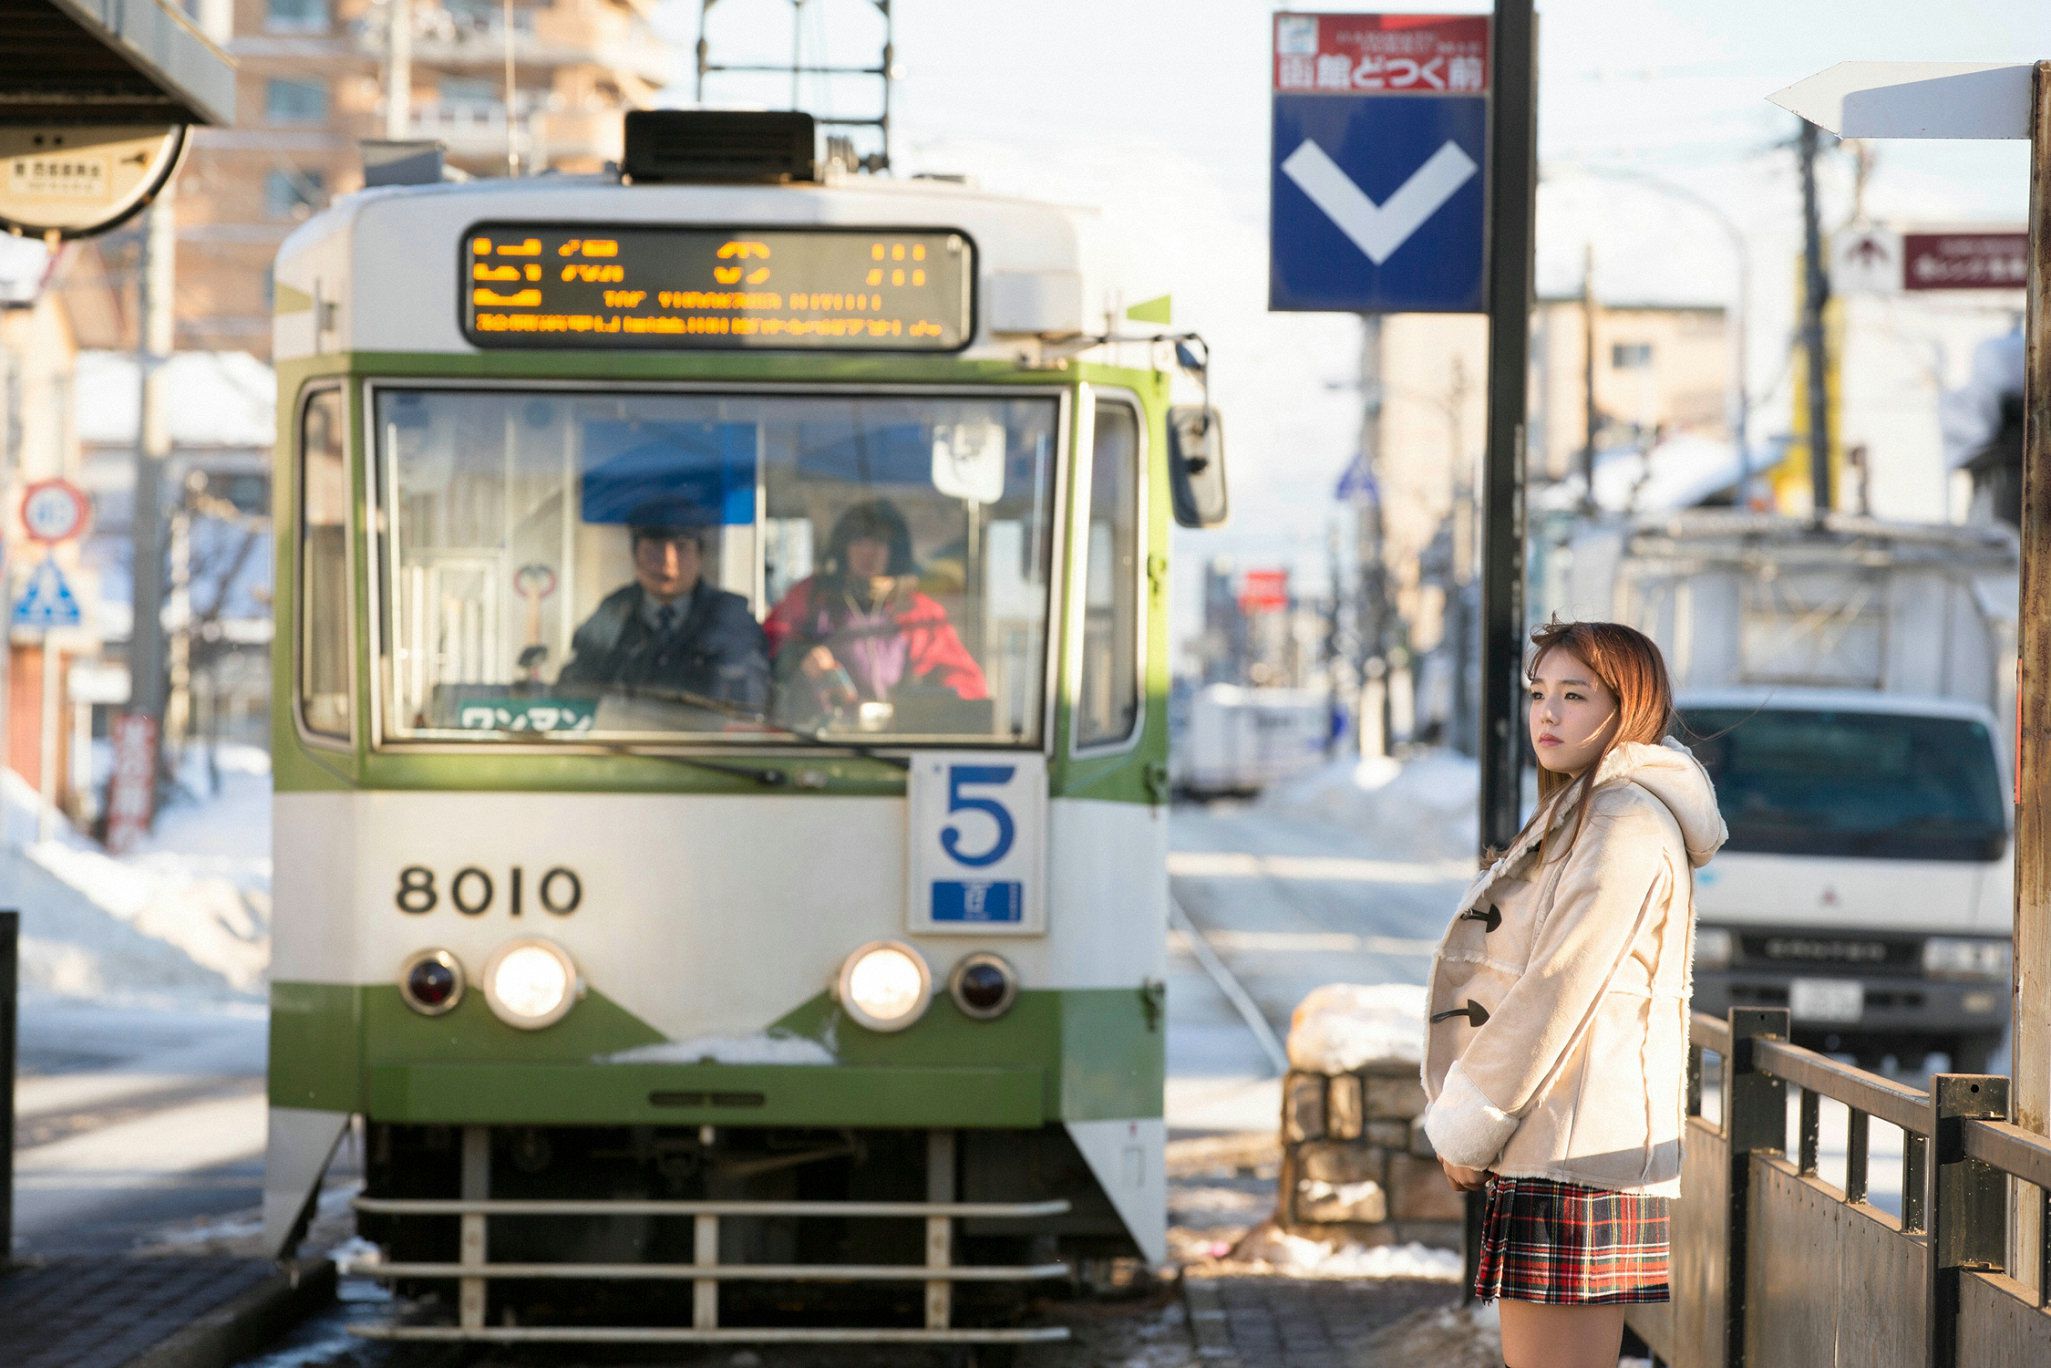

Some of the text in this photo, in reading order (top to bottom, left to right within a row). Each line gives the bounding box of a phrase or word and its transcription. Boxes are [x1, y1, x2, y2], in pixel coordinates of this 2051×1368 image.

[461, 706, 592, 734] ワンマン
[941, 766, 1017, 868] 5
[397, 866, 582, 915] 8010
